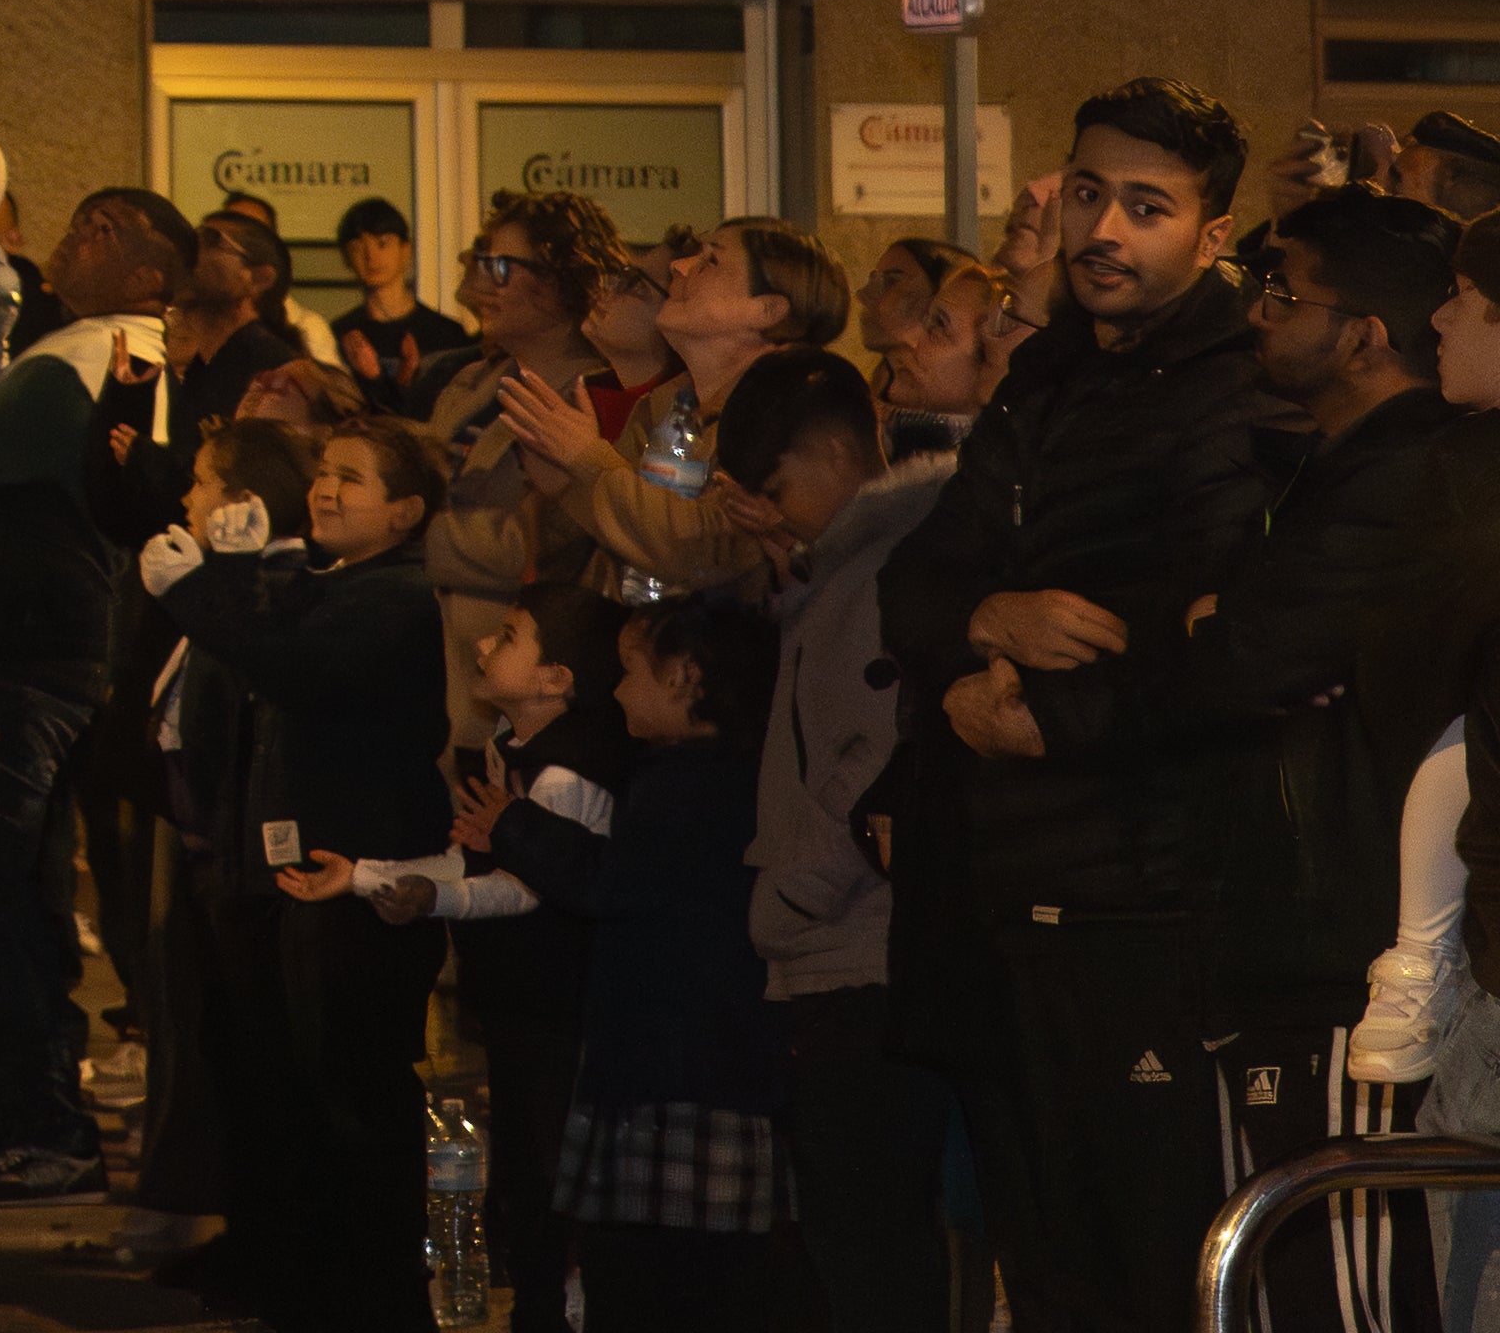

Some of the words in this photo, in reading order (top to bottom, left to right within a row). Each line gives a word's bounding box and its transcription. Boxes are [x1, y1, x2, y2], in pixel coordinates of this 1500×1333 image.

[859, 113, 982, 150] Cáma
[212, 147, 371, 194] Cámara
[522, 150, 680, 194] Cámara
